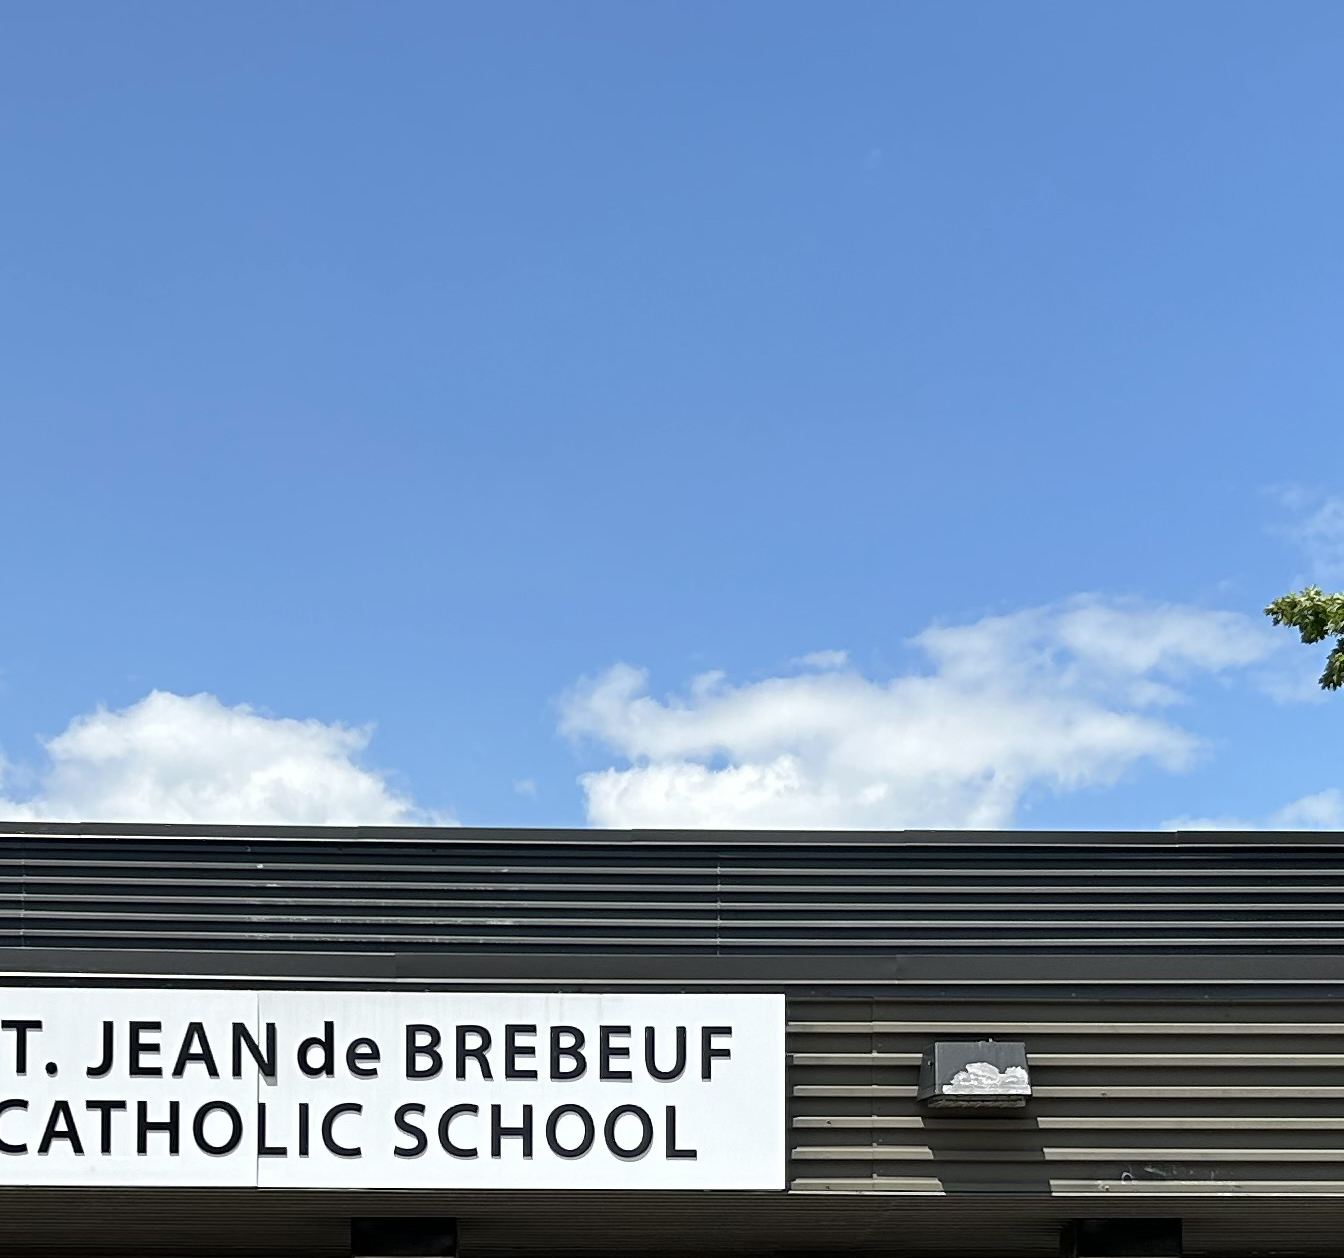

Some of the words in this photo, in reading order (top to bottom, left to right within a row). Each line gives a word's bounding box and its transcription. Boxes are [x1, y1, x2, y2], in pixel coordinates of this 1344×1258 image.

[86, 1020, 277, 1078] JEAN
[297, 1020, 381, 1078] de
[405, 1023, 733, 1081] BREBEUF
[393, 1102, 698, 1159] SCHOOL
